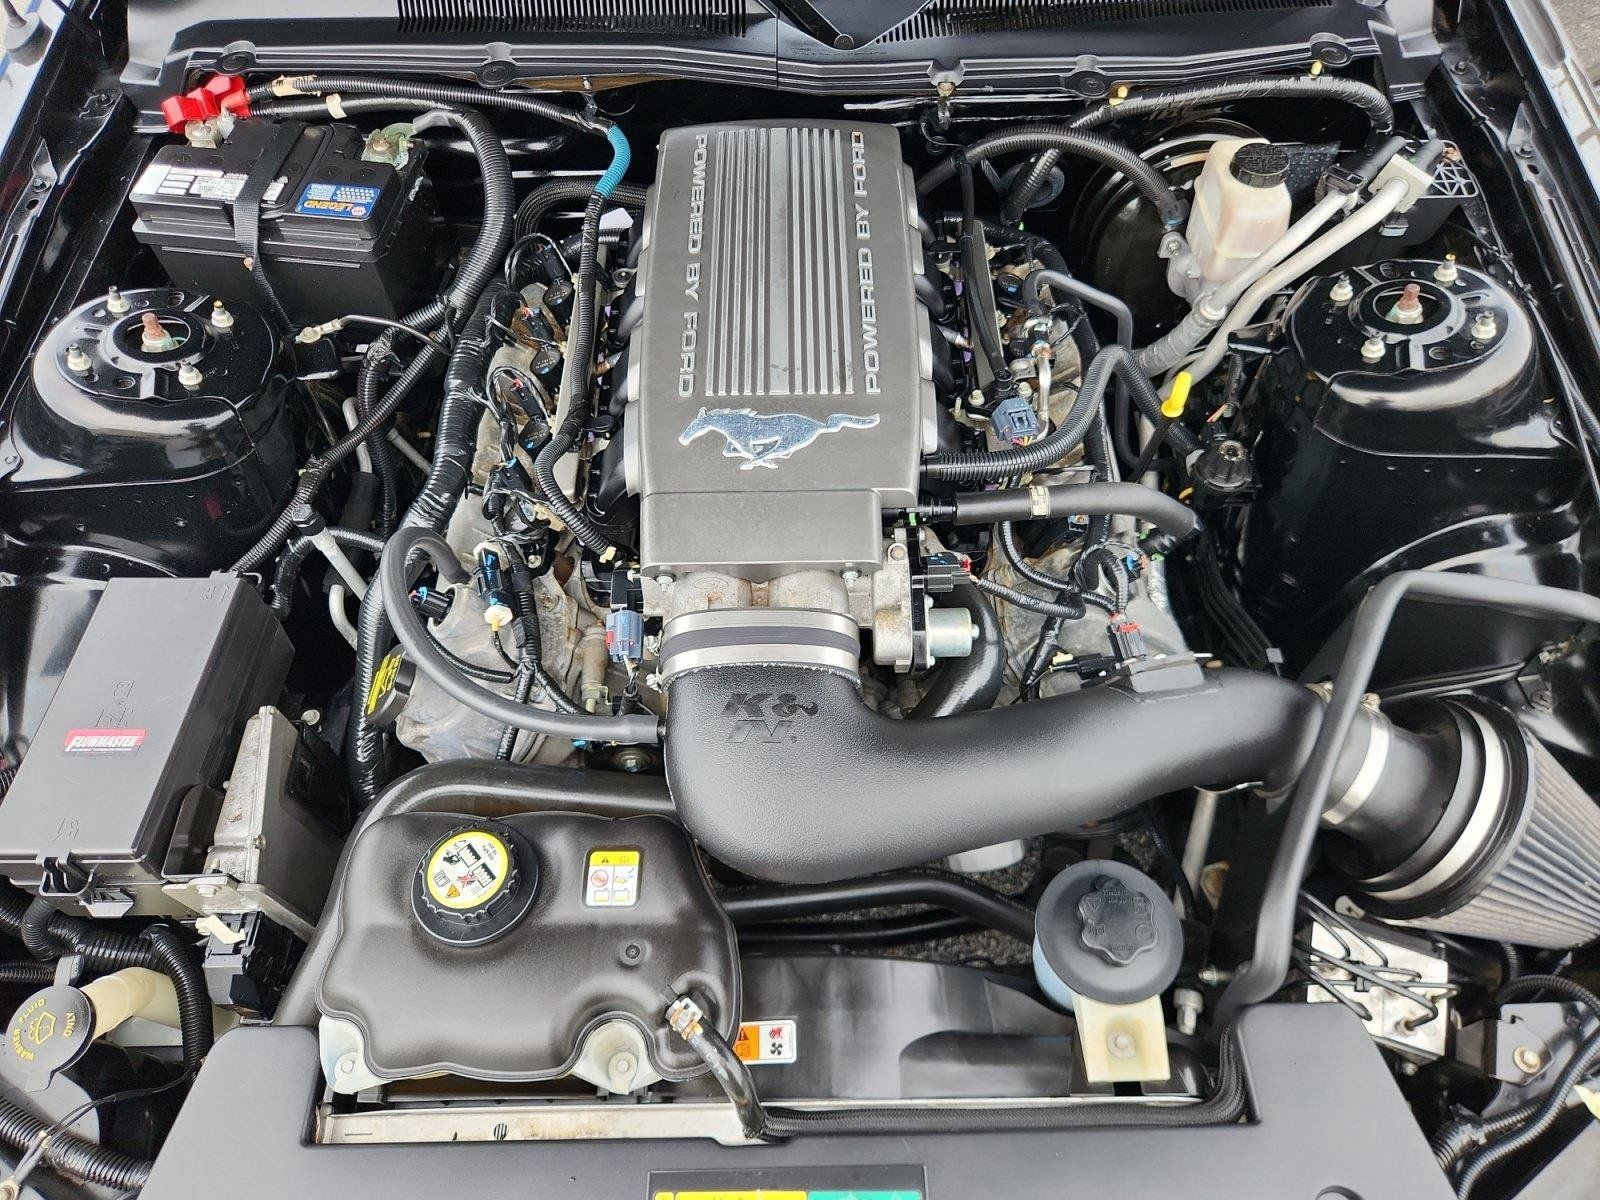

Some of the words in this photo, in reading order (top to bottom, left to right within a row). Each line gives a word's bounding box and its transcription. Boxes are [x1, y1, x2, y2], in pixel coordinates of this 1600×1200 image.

[851, 131, 868, 197] FORD
[303, 199, 355, 212] LEGEND
[688, 134, 708, 253] POWERED
[855, 203, 871, 238] BY
[685, 263, 701, 300] BY
[858, 247, 881, 394] POWERED
[679, 311, 698, 397] FORD
[65, 735, 137, 751] FLOWMASTER
[18, 998, 46, 1024] FLUID
[63, 1012, 77, 1038] ONLY
[13, 1028, 35, 1061] WASHER
